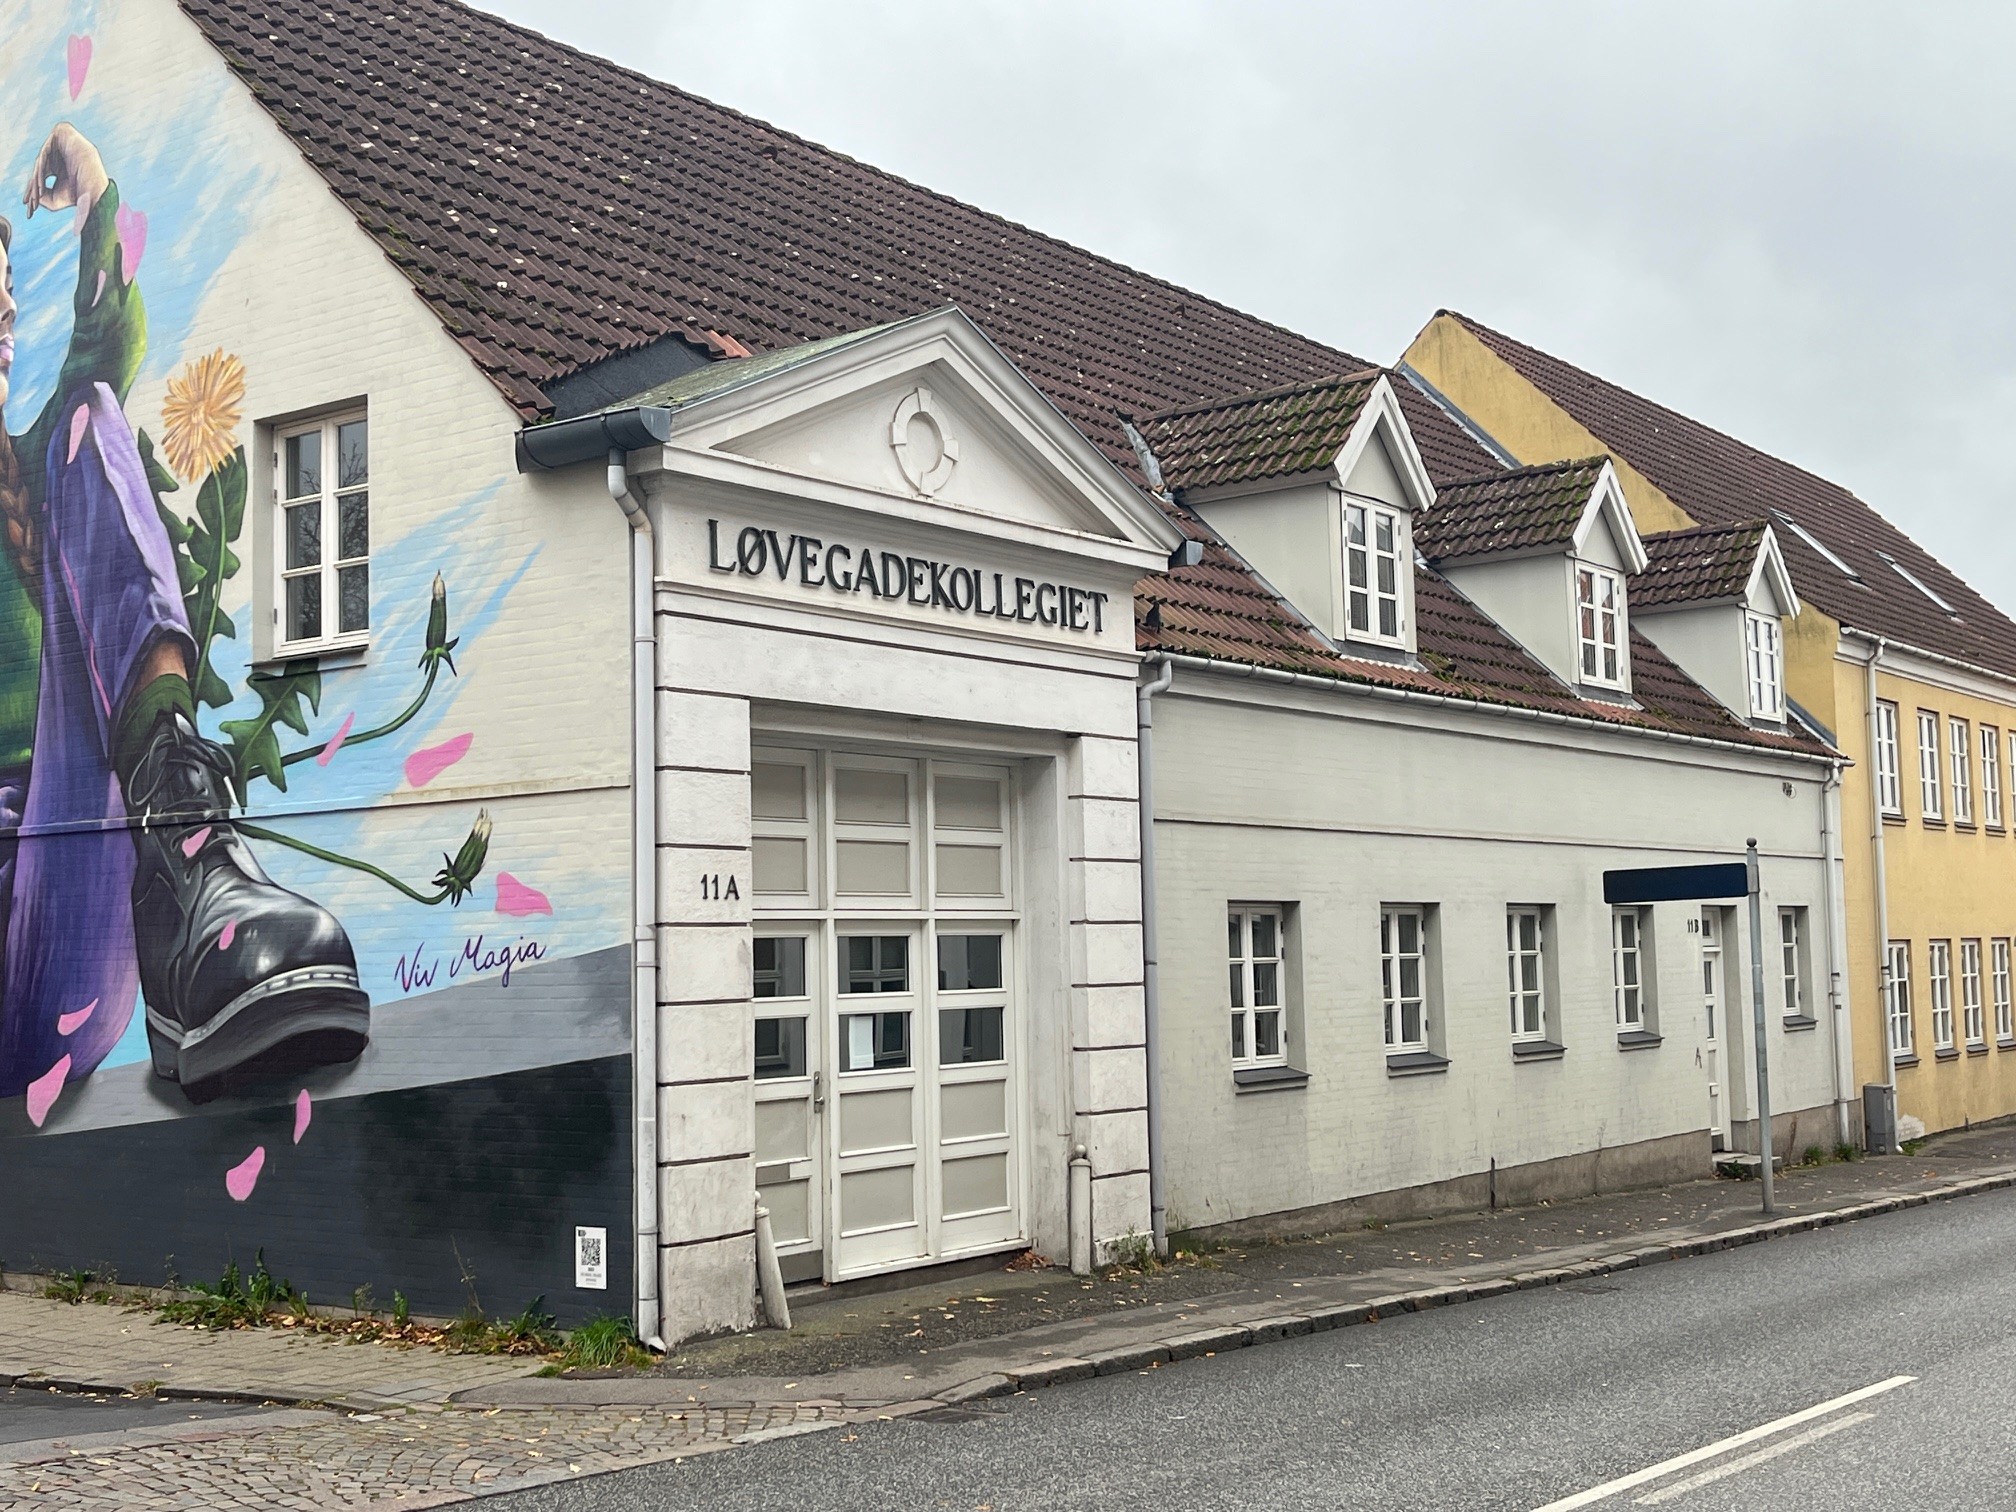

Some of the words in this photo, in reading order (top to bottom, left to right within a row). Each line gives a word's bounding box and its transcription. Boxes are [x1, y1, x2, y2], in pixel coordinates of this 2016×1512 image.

[708, 518, 1109, 632] LØVEGADEKOLLEGIET
[1687, 918, 1699, 933] 11B
[450, 934, 547, 988] Magia
